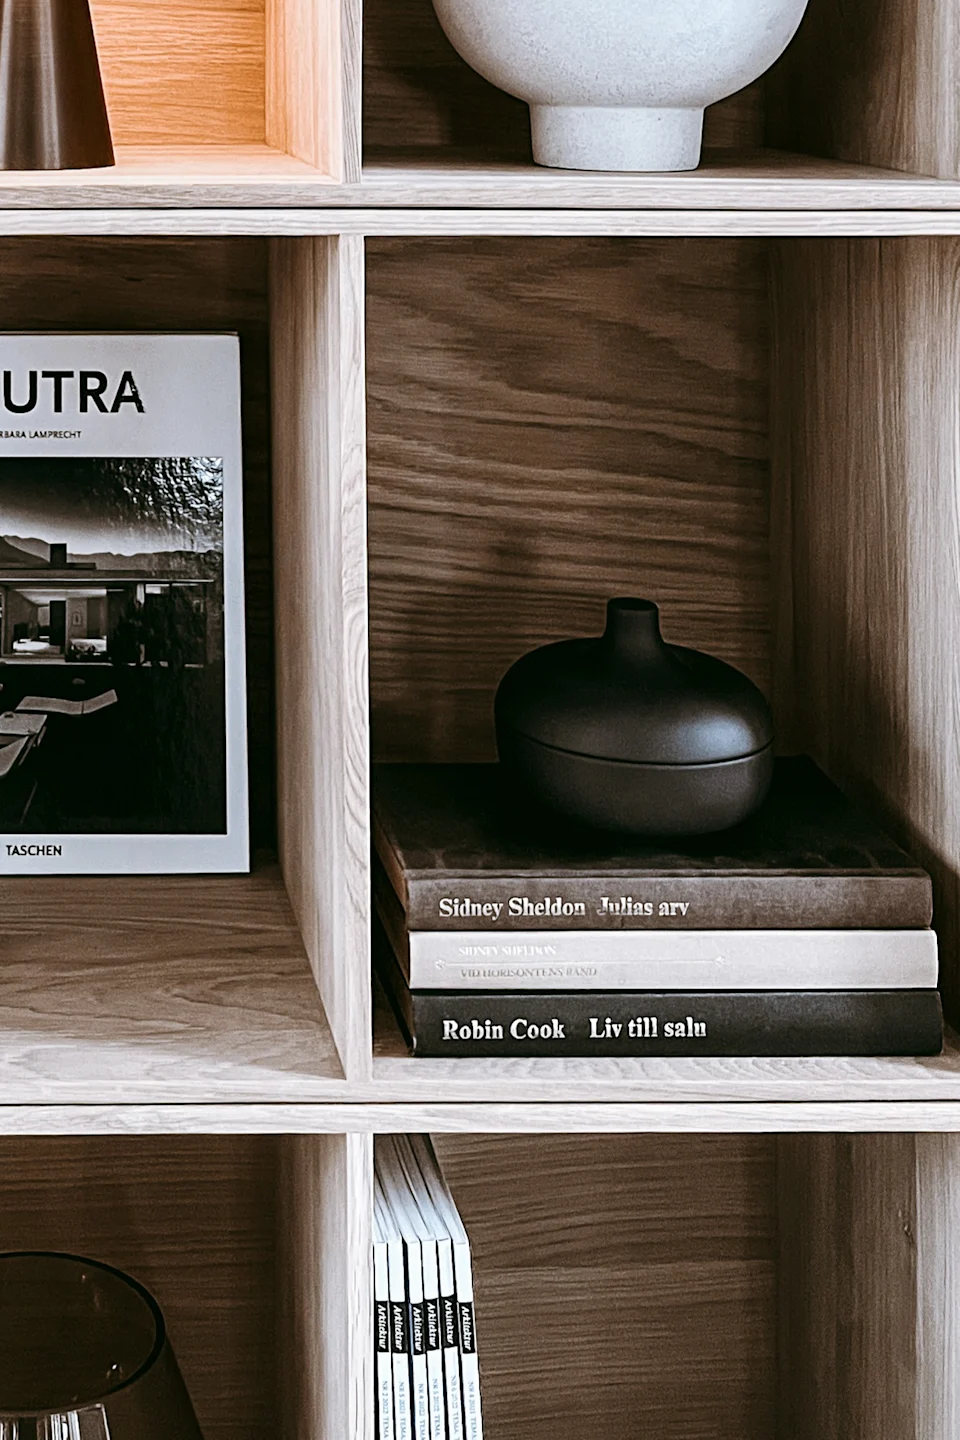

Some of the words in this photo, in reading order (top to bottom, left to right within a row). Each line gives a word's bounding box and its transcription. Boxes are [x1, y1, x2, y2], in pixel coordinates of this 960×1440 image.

[29, 430, 82, 439] LAMPRECHT
[5, 844, 62, 856] TASCHEN
[439, 897, 503, 921] Sidney
[508, 896, 586, 917] Sheldon
[596, 896, 653, 917] Julias
[658, 901, 690, 917] arv
[458, 946, 499, 956] SIDNEY
[501, 945, 557, 956] SHELDON
[460, 969, 481, 978] VID
[482, 968, 563, 978] HORISONTENS
[442, 1019, 504, 1040] Robin
[509, 1018, 566, 1040] Cook
[589, 1017, 623, 1038] Liv
[627, 1017, 658, 1038] till
[663, 1016, 707, 1038] salu
[377, 1304, 387, 1349] Arkitektur
[393, 1304, 404, 1350] Arkitektur
[413, 1307, 423, 1351] Arkitektur
[427, 1302, 437, 1347] Arkitektur
[444, 1300, 455, 1344] Arkitektur
[461, 1306, 472, 1350] Arkitektur
